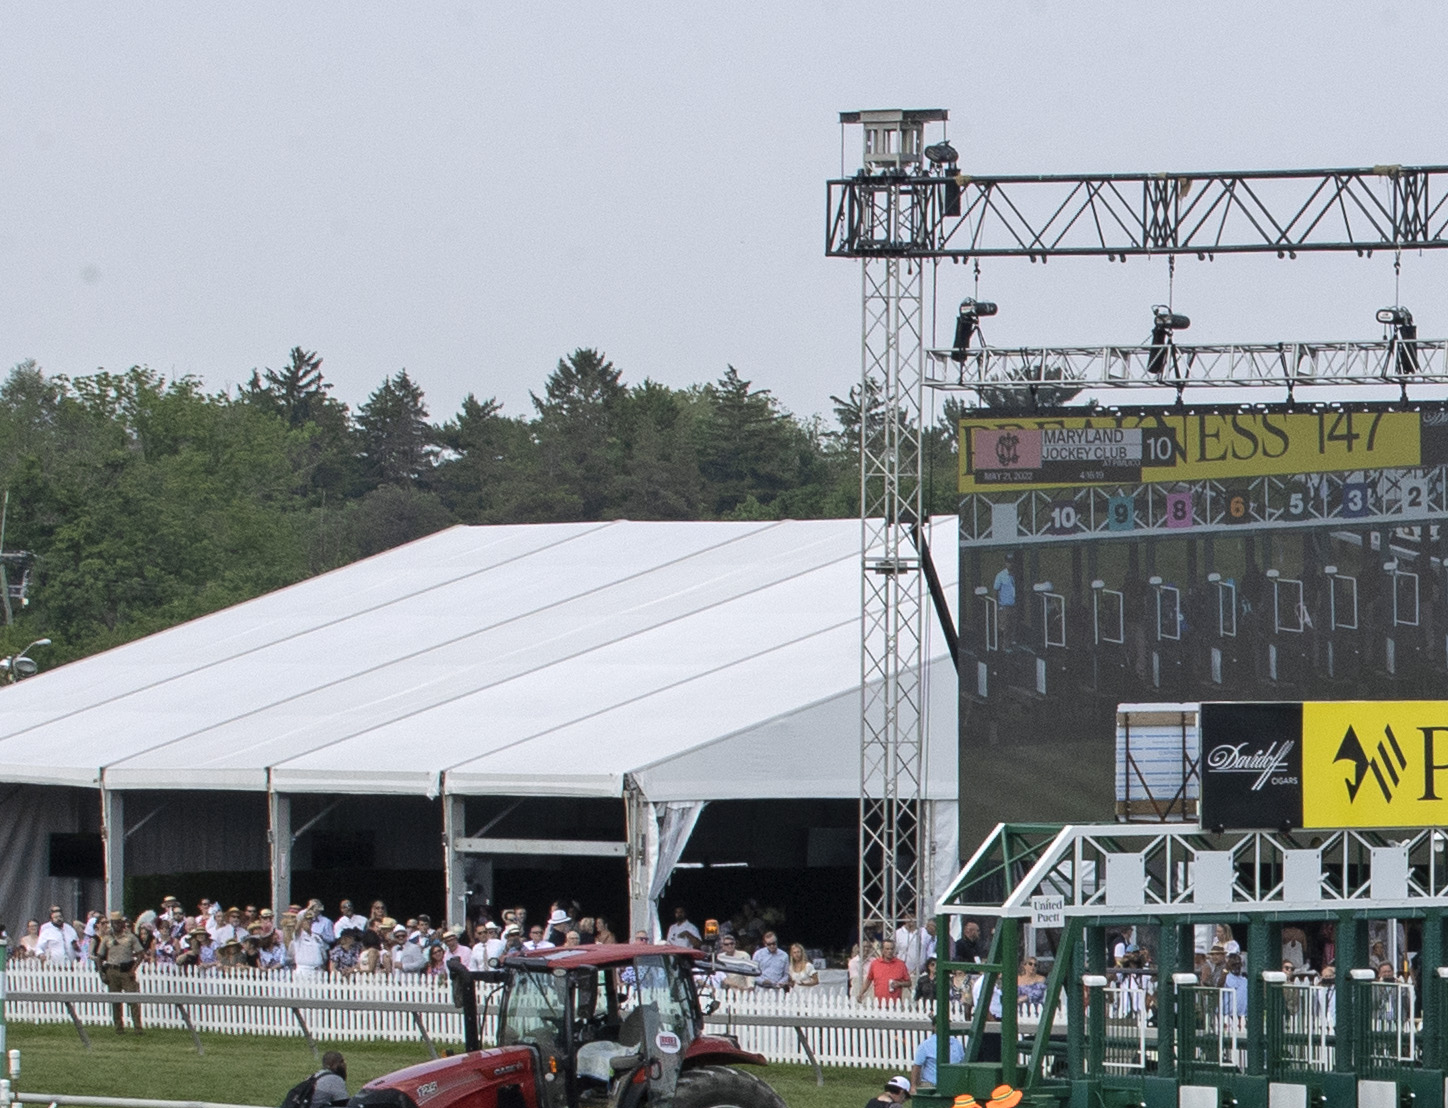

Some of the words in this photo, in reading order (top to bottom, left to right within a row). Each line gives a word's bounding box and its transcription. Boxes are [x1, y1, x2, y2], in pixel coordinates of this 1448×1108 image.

[1043, 429, 1124, 444] MARYLAND
[1316, 412, 1384, 455] 147
[1042, 447, 1092, 460] JOCKEY
[1094, 446, 1127, 459] CLUB
[1146, 436, 1173, 461] 10
[1290, 493, 1304, 515] 5
[1348, 490, 1362, 510] 3
[1408, 487, 1421, 506] 2
[1051, 506, 1076, 528] 10
[1114, 503, 1129, 523] 9
[1172, 500, 1187, 521] 8
[1230, 497, 1245, 517] 6
[1208, 740, 1295, 790] Davidoff
[1271, 777, 1298, 785] CIGARS
[1034, 900, 1063, 910] United
[1038, 914, 1060, 922] Puett
